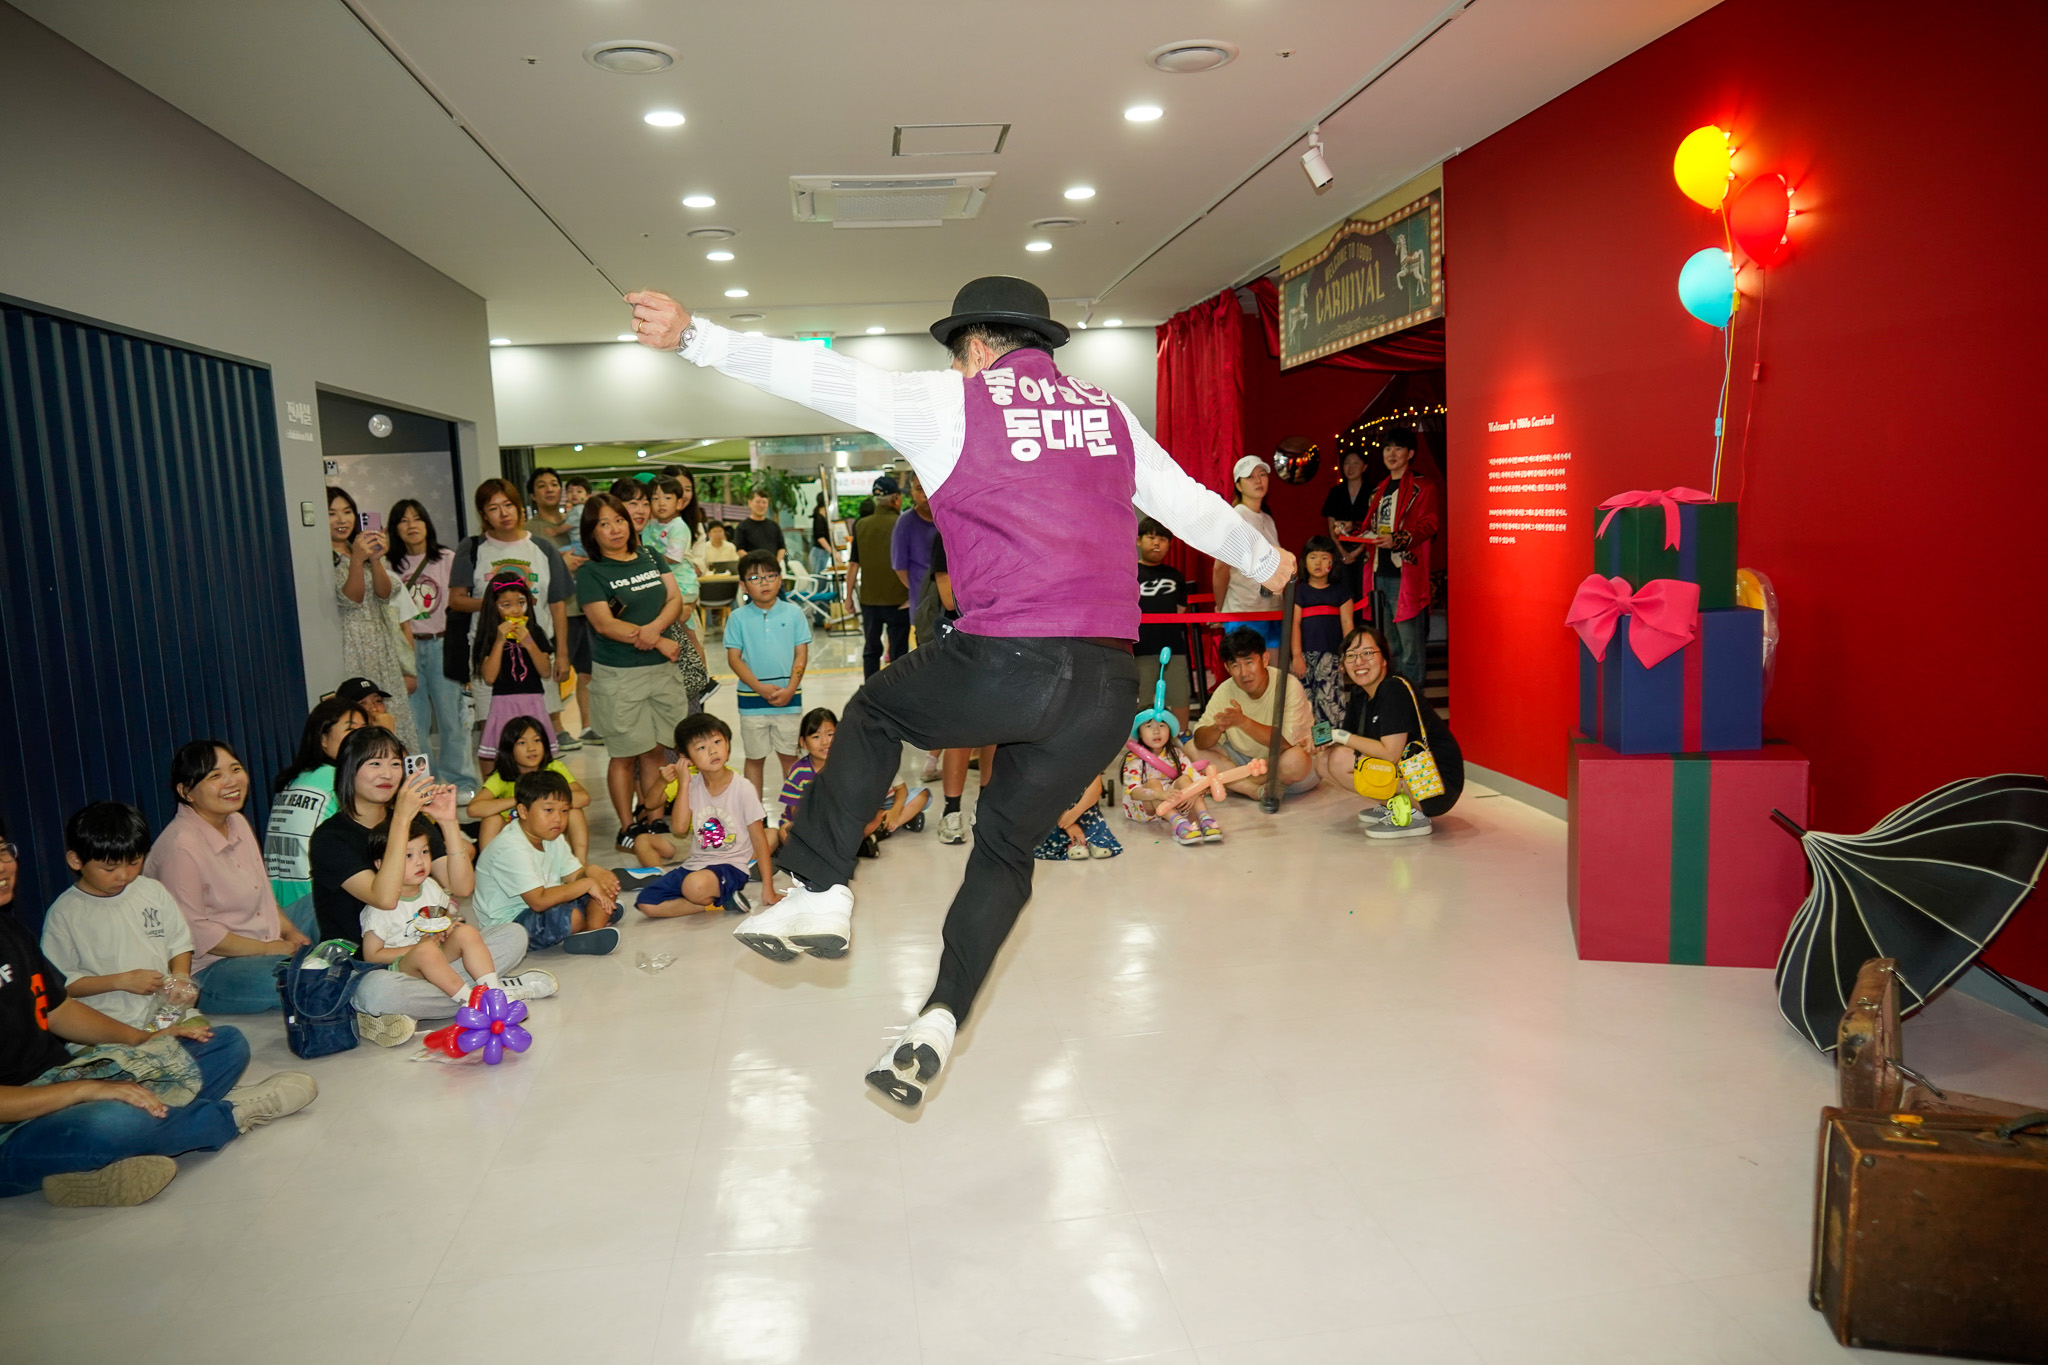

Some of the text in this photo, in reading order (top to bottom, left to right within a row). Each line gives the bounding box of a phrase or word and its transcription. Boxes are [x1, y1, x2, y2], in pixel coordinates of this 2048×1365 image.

[1316, 261, 1385, 325] CARNIVAL
[1488, 421, 1509, 432] Welcome
[1531, 413, 1554, 427] Carnival
[1003, 409, 1118, 462] 동대문
[609, 578, 630, 589] LOS
[287, 793, 319, 811] HEART
